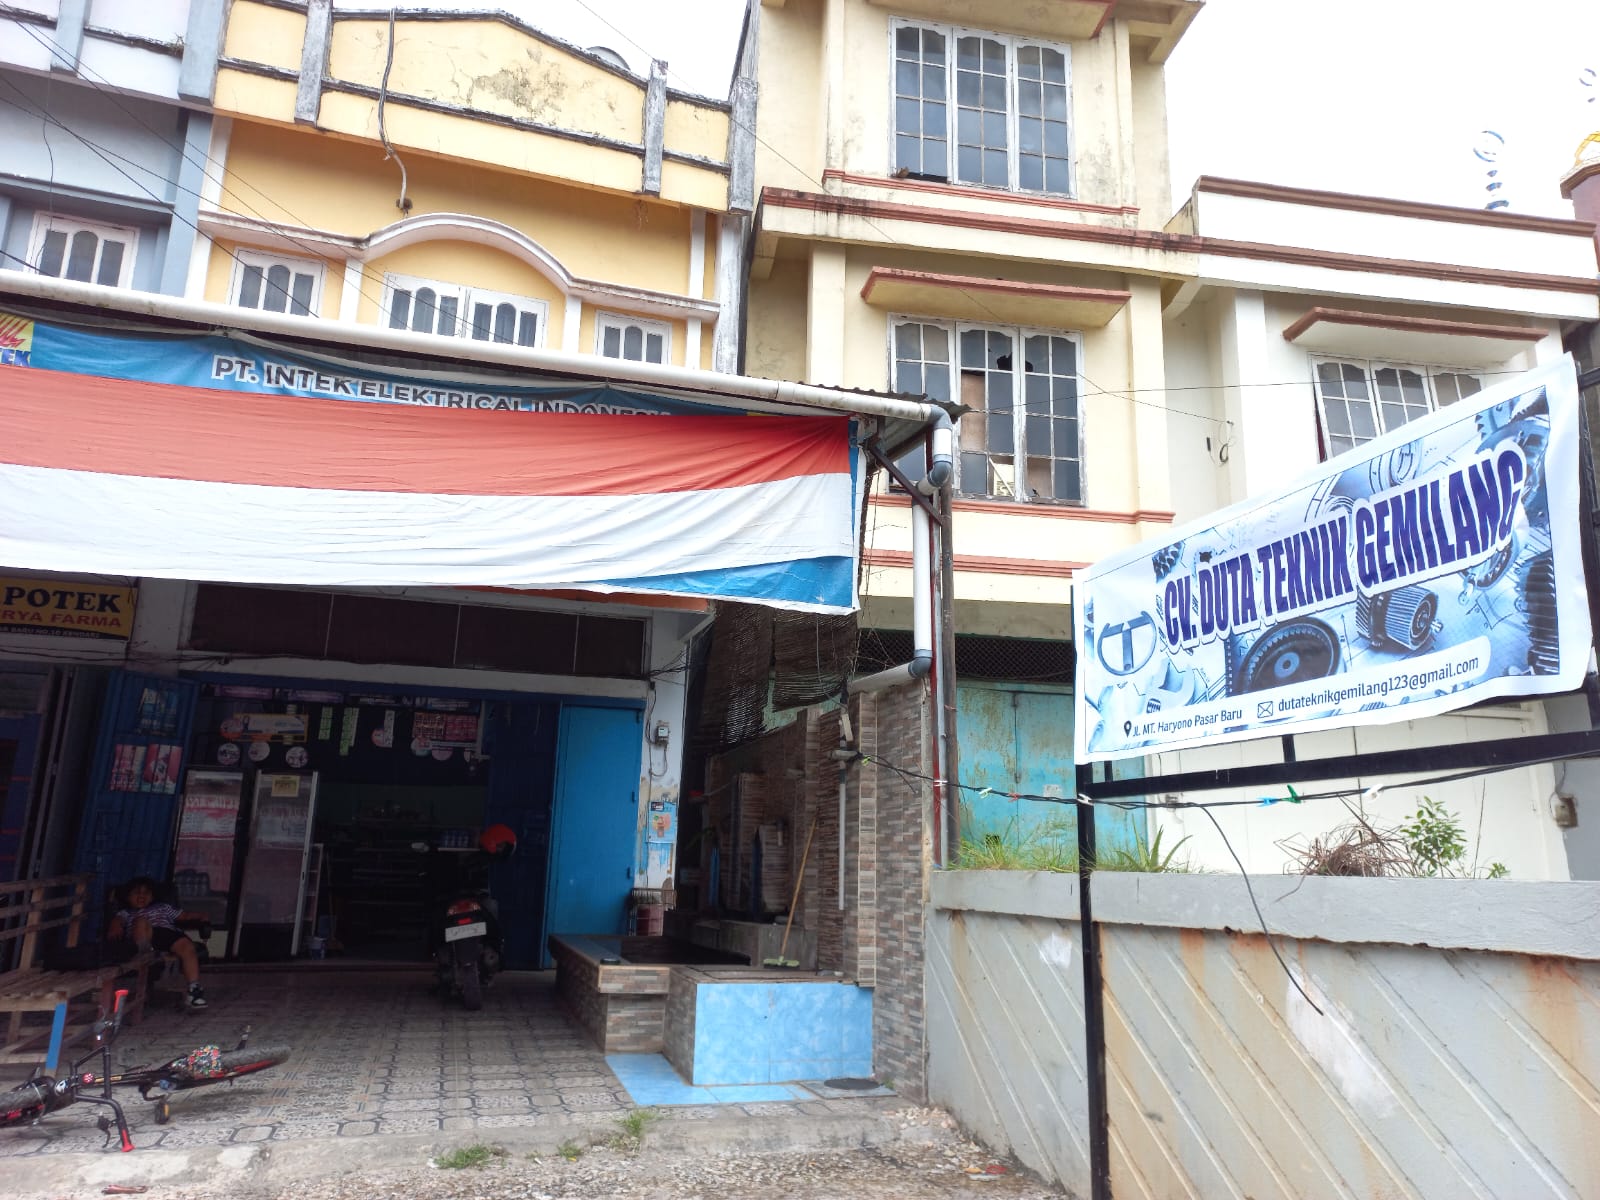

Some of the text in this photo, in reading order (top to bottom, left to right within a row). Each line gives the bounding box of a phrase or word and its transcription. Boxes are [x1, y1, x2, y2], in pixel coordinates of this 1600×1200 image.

[0, 349, 31, 367] EK
[213, 357, 258, 382] PT.
[265, 363, 354, 396] INTEK
[359, 379, 528, 412] ELEKTRICAL
[1164, 450, 1523, 646] CV. DUTA TEKNIK GEMILANG
[51, 612, 121, 628] FARMA
[1278, 657, 1479, 712] dutateknikgemilang123@gmail.com
[1143, 723, 1156, 735] MT.
[1158, 720, 1193, 735] Haryono
[1195, 714, 1219, 727] Pasar
[1221, 709, 1242, 722] Baru
